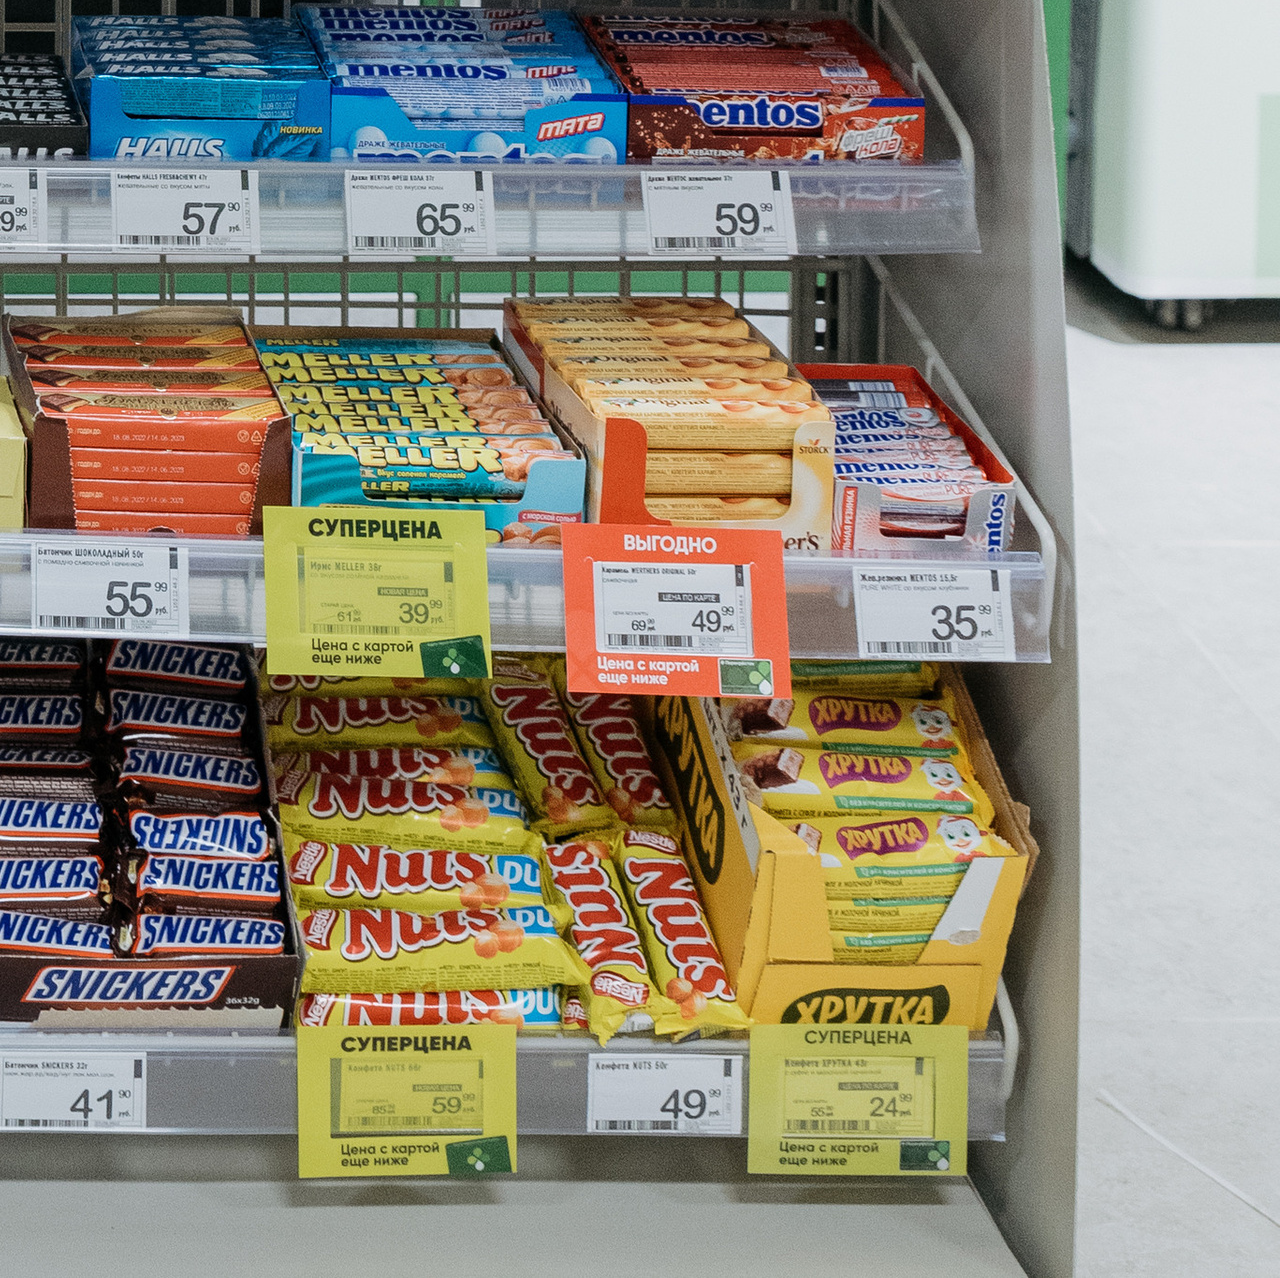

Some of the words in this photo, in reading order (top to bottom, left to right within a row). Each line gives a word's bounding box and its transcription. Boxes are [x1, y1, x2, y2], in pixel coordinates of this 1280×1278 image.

[342, 61, 506, 80] mentos
[279, 125, 324, 135] НОВИНКА
[182, 201, 226, 236] 57
[416, 203, 463, 236] 65
[715, 202, 761, 236] 59
[279, 383, 457, 404] MELLER
[798, 444, 833, 455] STORCK
[308, 517, 442, 541] СУПЕРЦЕНА
[623, 533, 717, 555] ВЫГОДНО
[105, 581, 152, 617] 55
[691, 608, 722, 633] 49
[930, 604, 977, 640] 35
[813, 697, 900, 726] ХРУТКА
[839, 820, 925, 851] ХРУТКА
[324, 843, 492, 898] Nuts
[142, 914, 284, 947] SNICKERS
[35, 967, 224, 1002] SNICKERS
[340, 1035, 472, 1054] СУПЕРЦЕНА
[804, 1029, 912, 1047] СУПЕРЦЕНА
[70, 1088, 114, 1120] 41
[660, 1088, 707, 1120] 49
